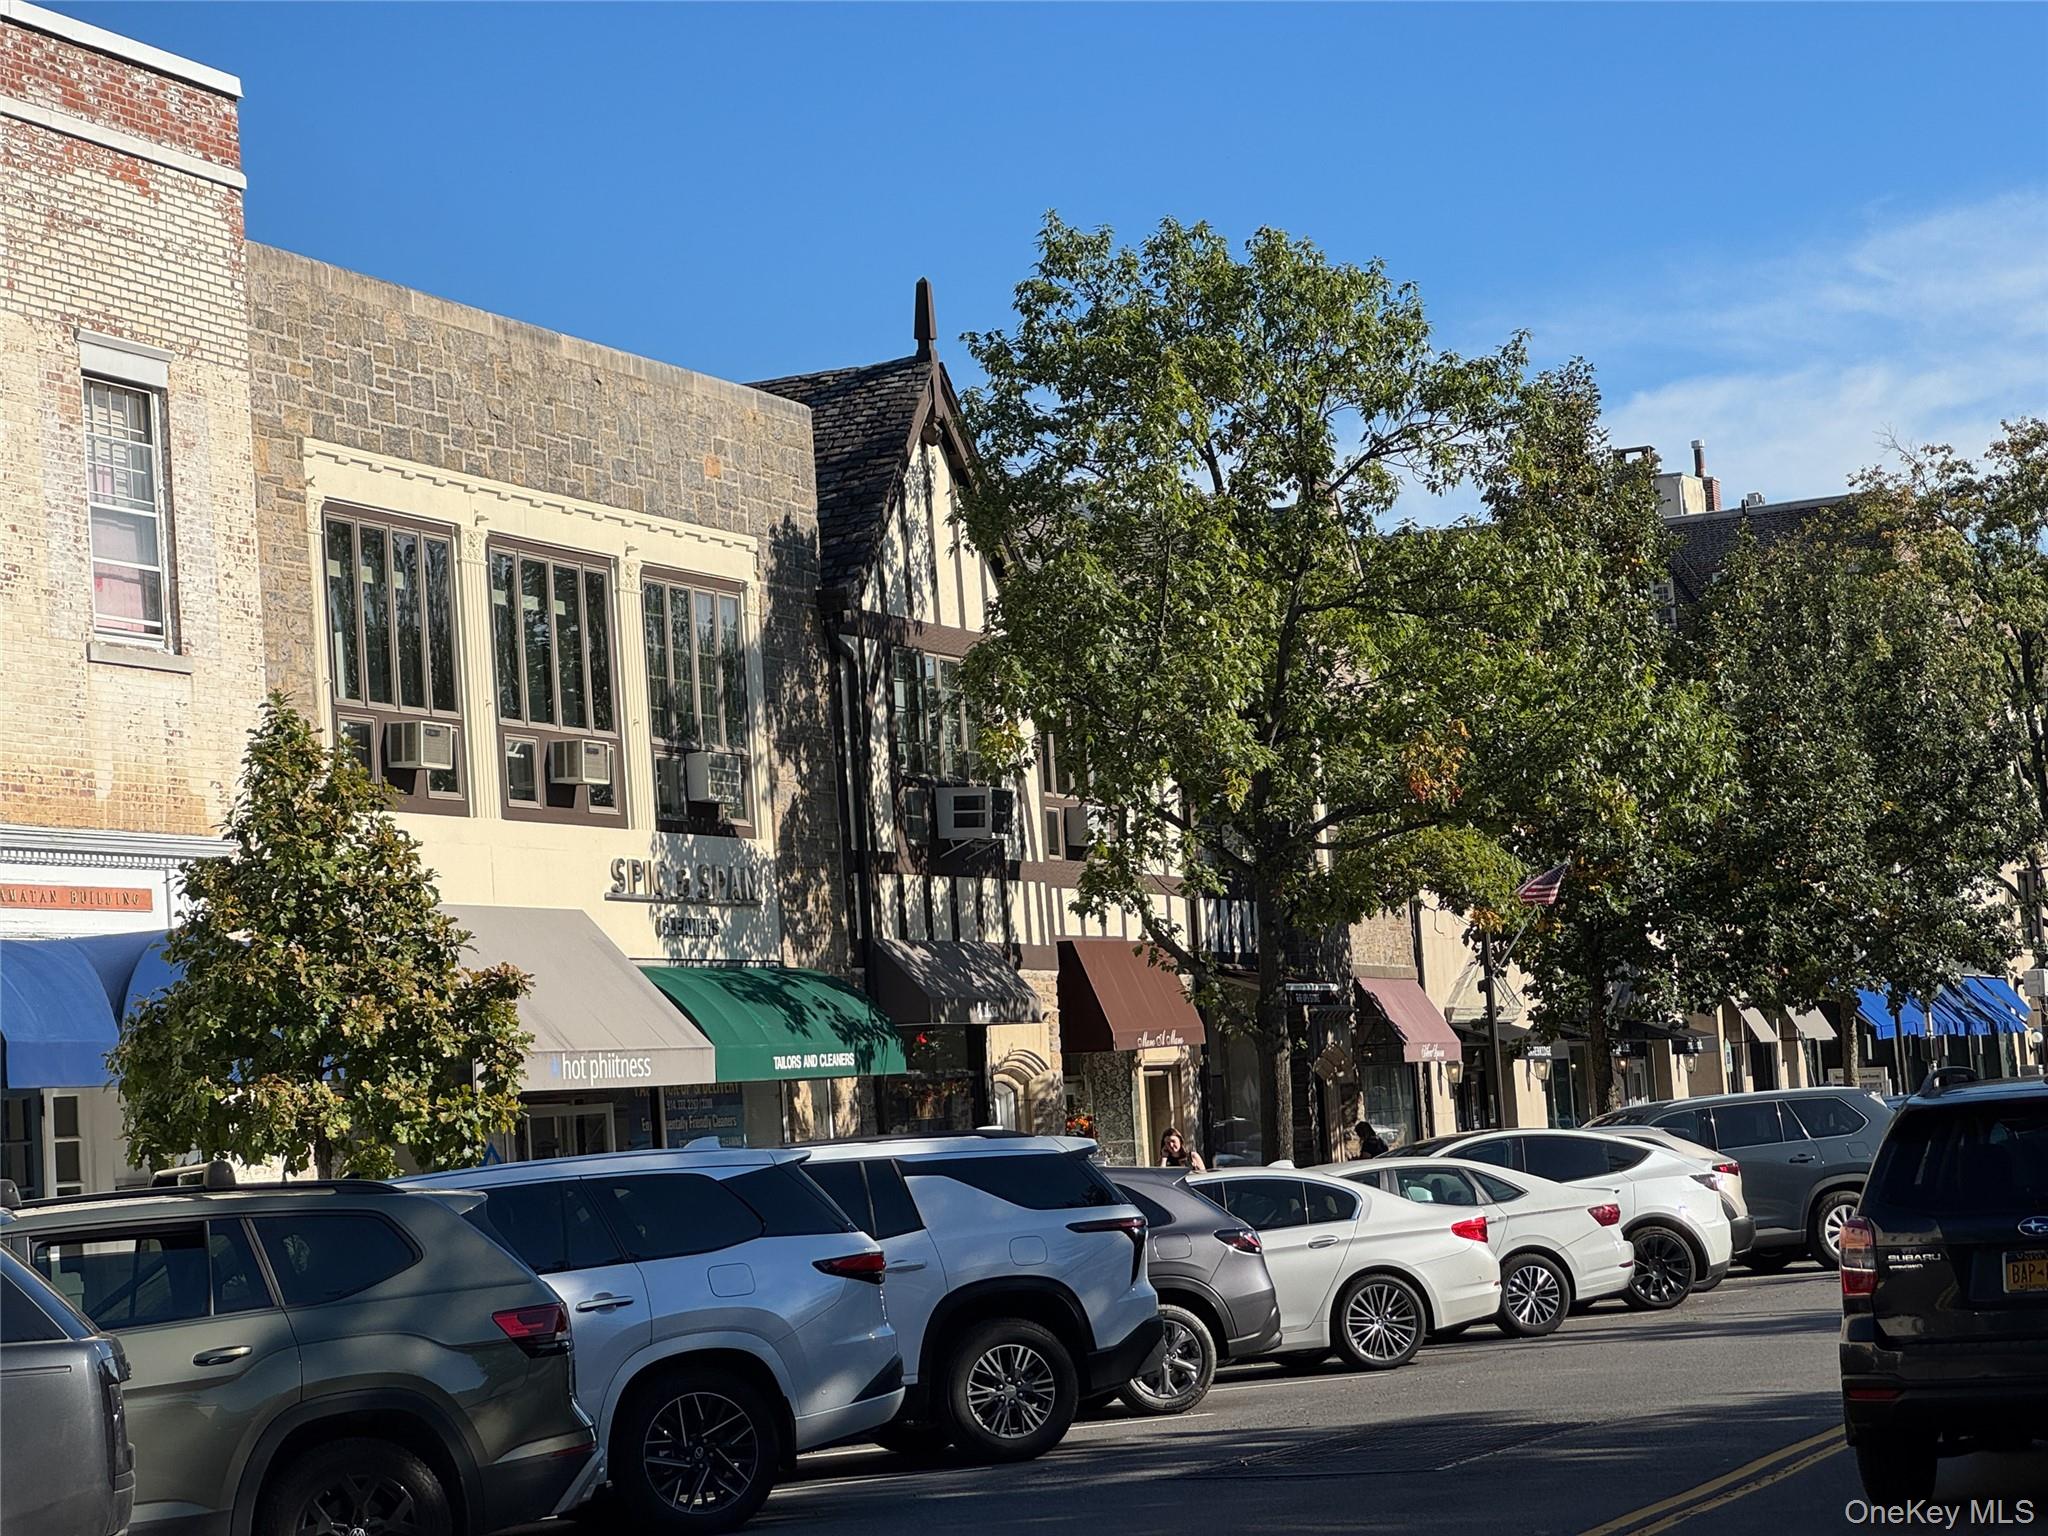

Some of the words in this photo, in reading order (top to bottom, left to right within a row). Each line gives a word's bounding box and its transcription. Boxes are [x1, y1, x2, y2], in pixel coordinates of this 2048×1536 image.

[611, 858, 668, 899] SPIC
[676, 868, 691, 898] &
[697, 864, 757, 901] SPAN
[70, 891, 141, 905] BUILDING
[656, 917, 720, 938] CLEANERS
[562, 1052, 588, 1080] hot
[590, 1052, 652, 1087] phiitness
[773, 1055, 802, 1070] TAILORS
[803, 1054, 818, 1068] AND
[820, 1052, 855, 1067] CLEANERS
[689, 1115, 711, 1131] Friendly
[712, 1113, 737, 1128] Cleaners
[1888, 1253, 1942, 1262] SUBARU
